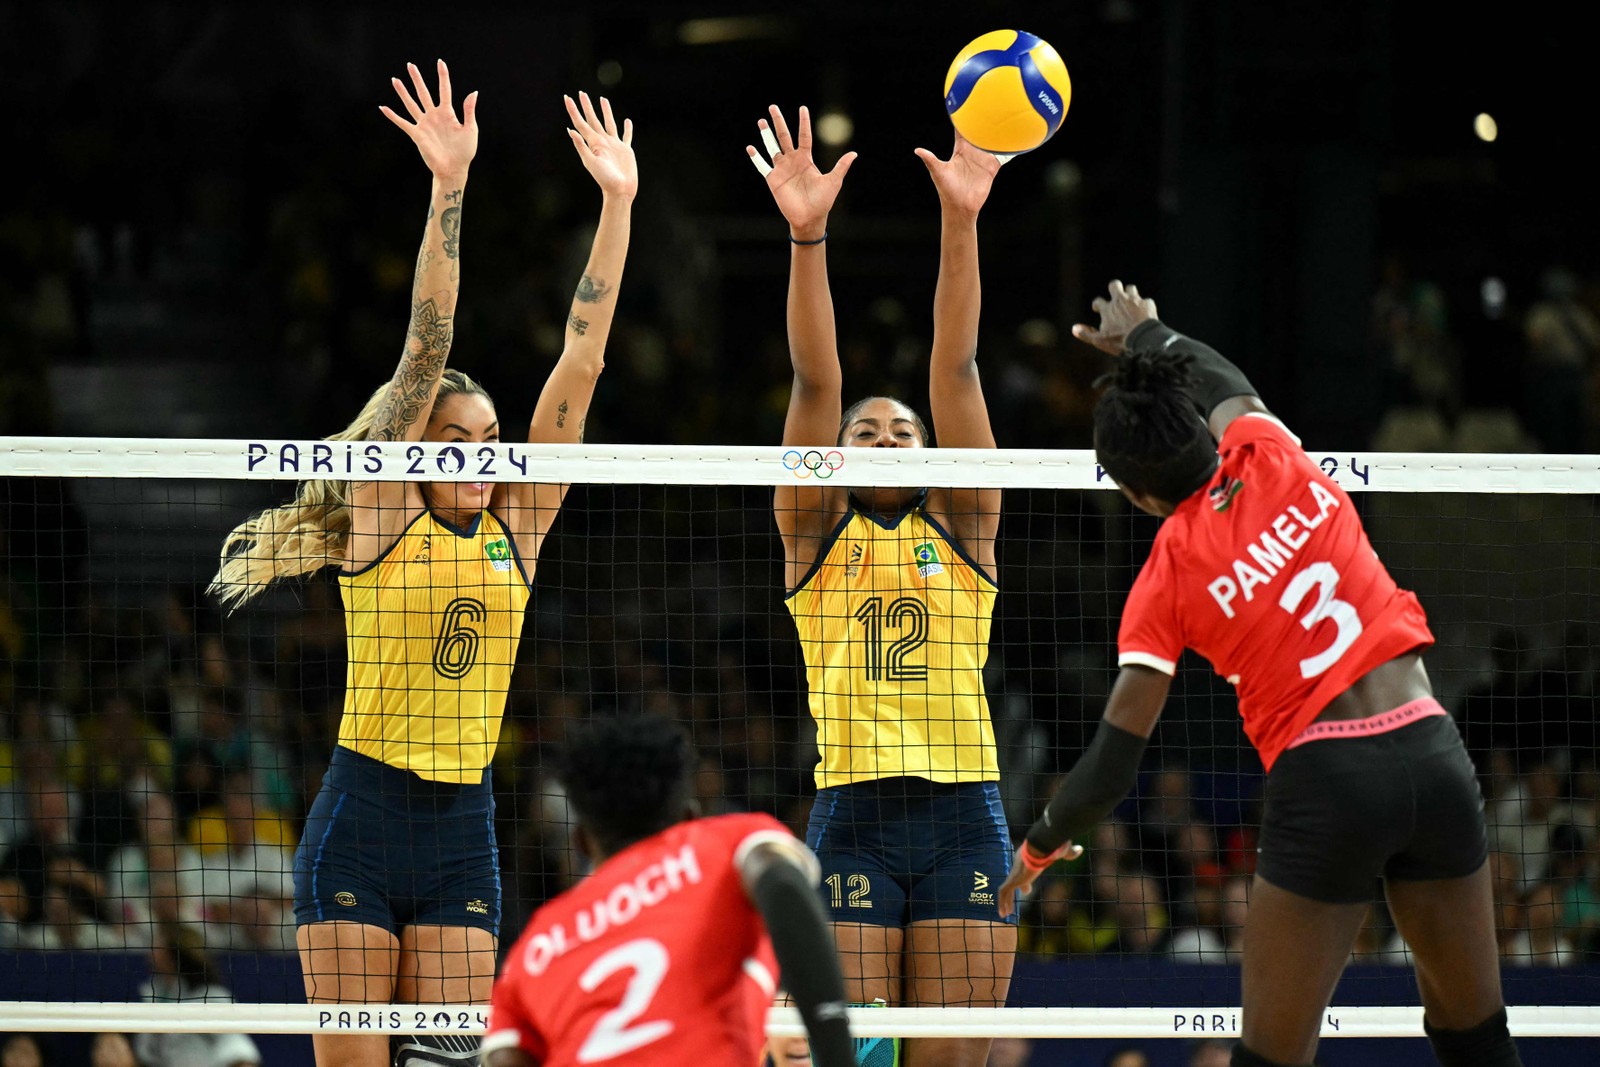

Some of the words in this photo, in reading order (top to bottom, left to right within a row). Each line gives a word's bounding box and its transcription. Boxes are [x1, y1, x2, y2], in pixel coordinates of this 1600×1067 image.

[1038, 90, 1059, 115] V200W
[406, 445, 527, 476] 2024
[1207, 480, 1340, 619] PAMELA
[1278, 561, 1363, 679] 3
[433, 597, 487, 680] 6
[854, 596, 929, 681] 12
[825, 873, 873, 908] 12
[968, 897, 995, 906] WORK
[970, 891, 994, 899] BODY
[466, 905, 489, 915] WORK
[523, 845, 702, 977] OLUOCH
[576, 937, 675, 1064] 2
[415, 1011, 488, 1029] 2024
